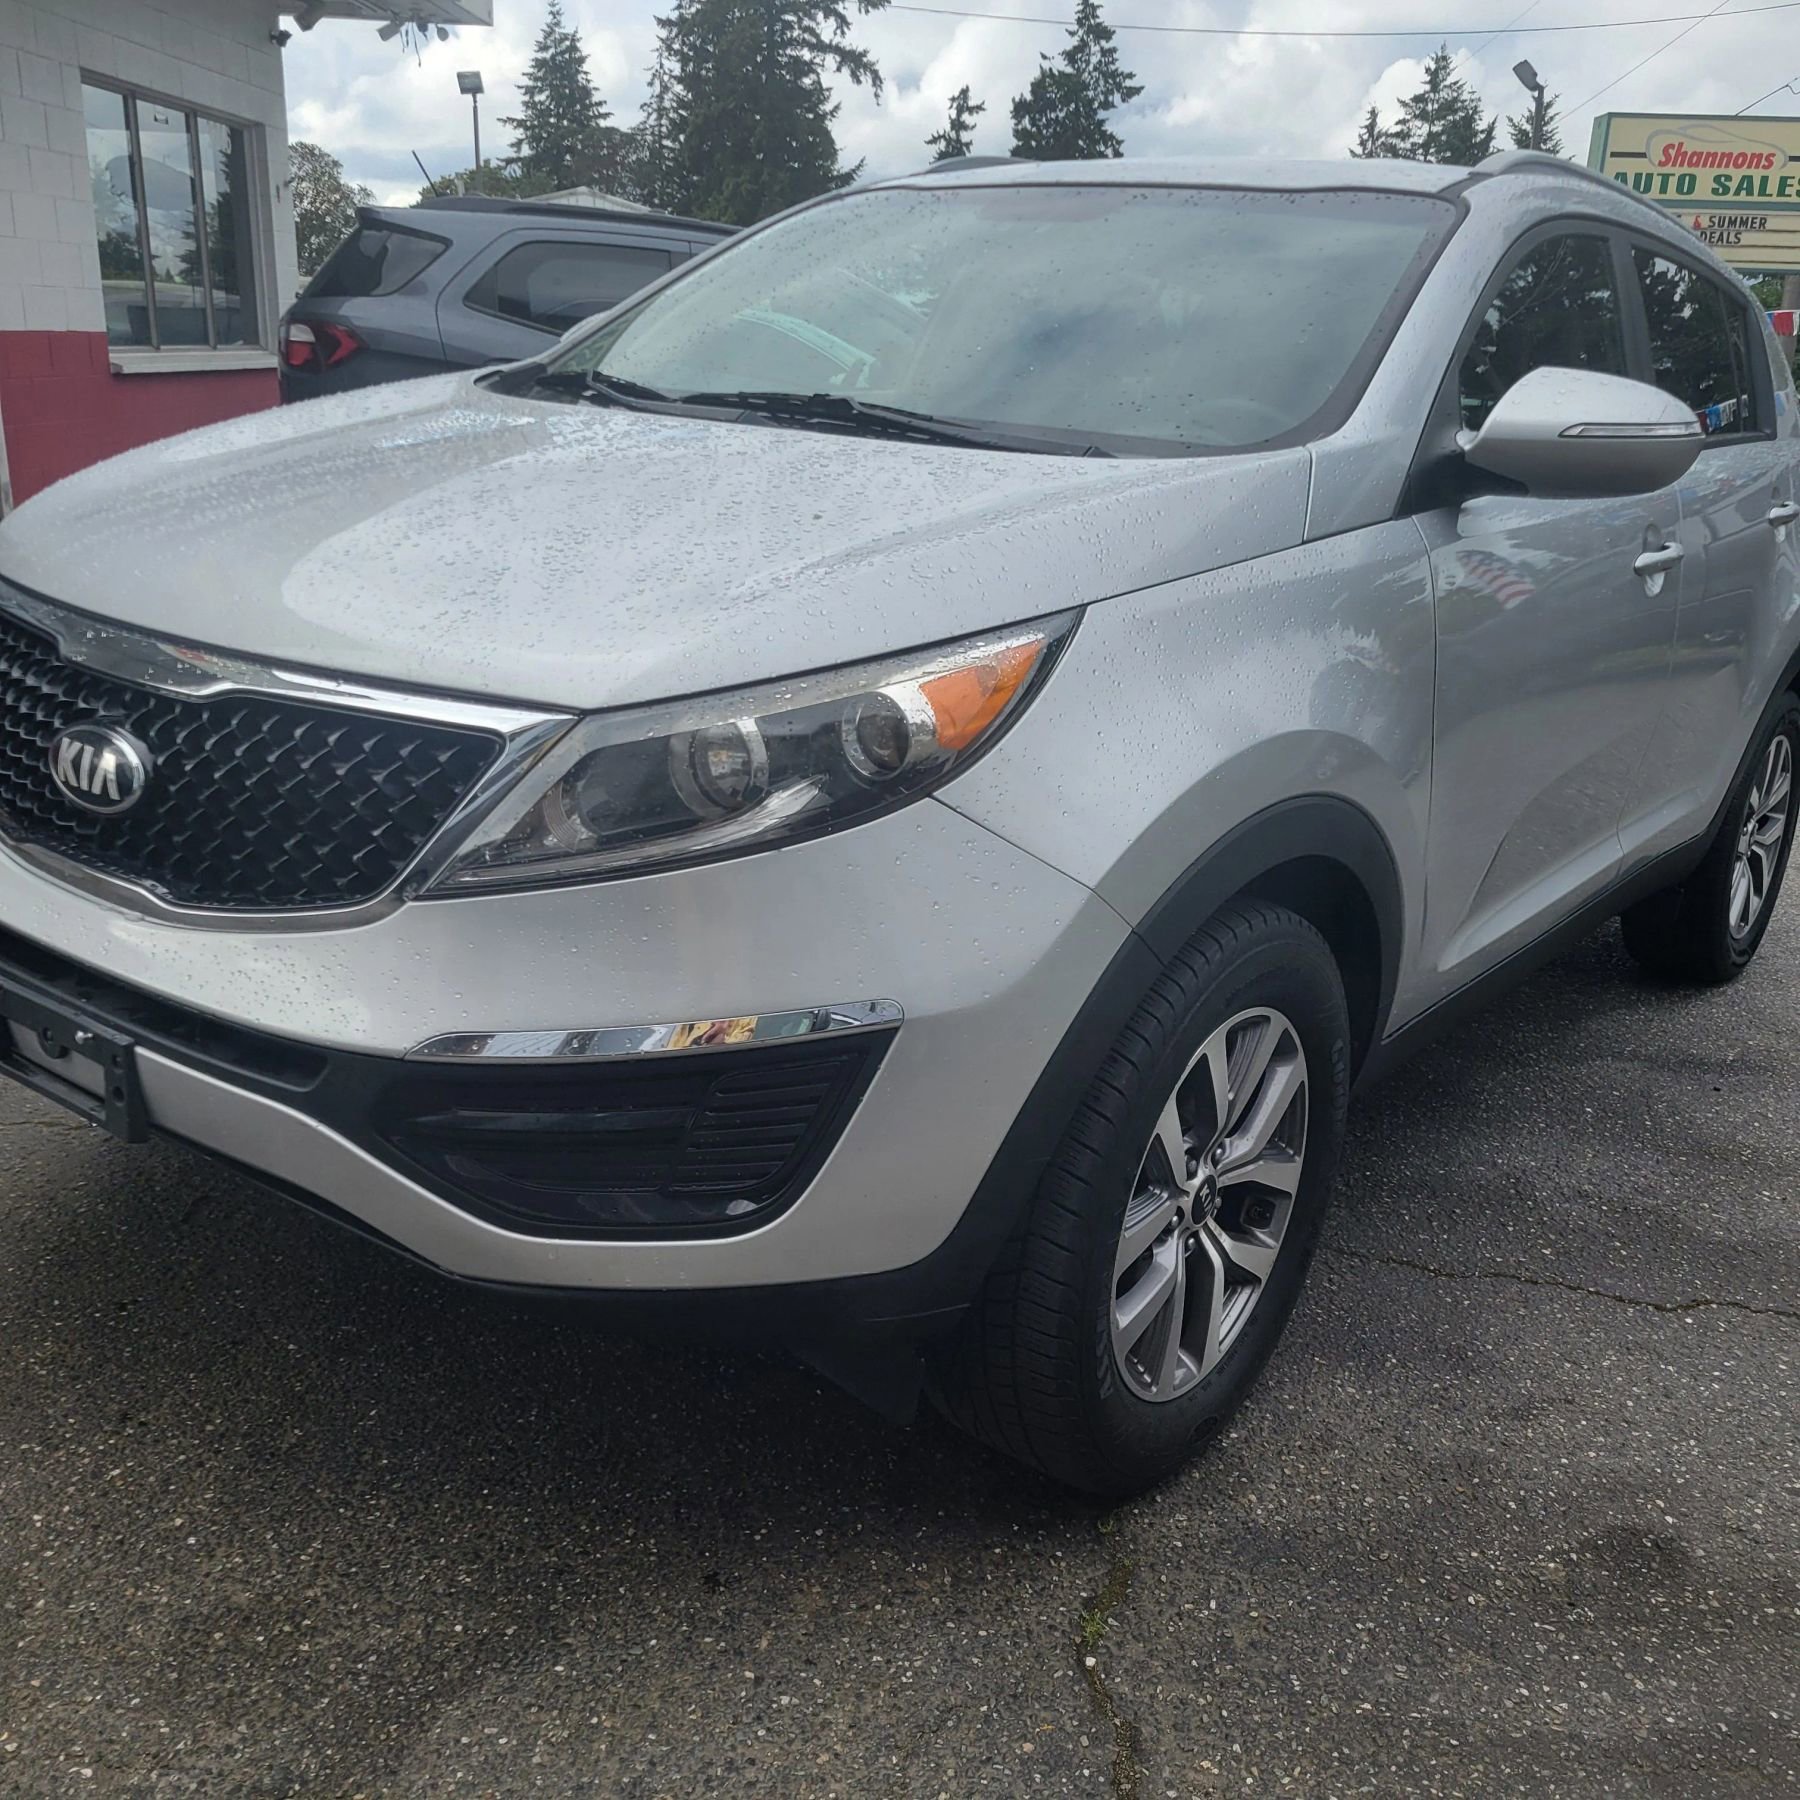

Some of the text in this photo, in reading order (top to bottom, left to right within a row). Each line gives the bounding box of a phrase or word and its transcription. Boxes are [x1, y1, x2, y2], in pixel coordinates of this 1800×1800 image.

[1658, 142, 1776, 169] Shannons
[1711, 174, 1800, 198] SALE
[1708, 215, 1767, 230] SUMMER
[1700, 231, 1742, 245] DEALS
[58, 737, 120, 800] KIA
